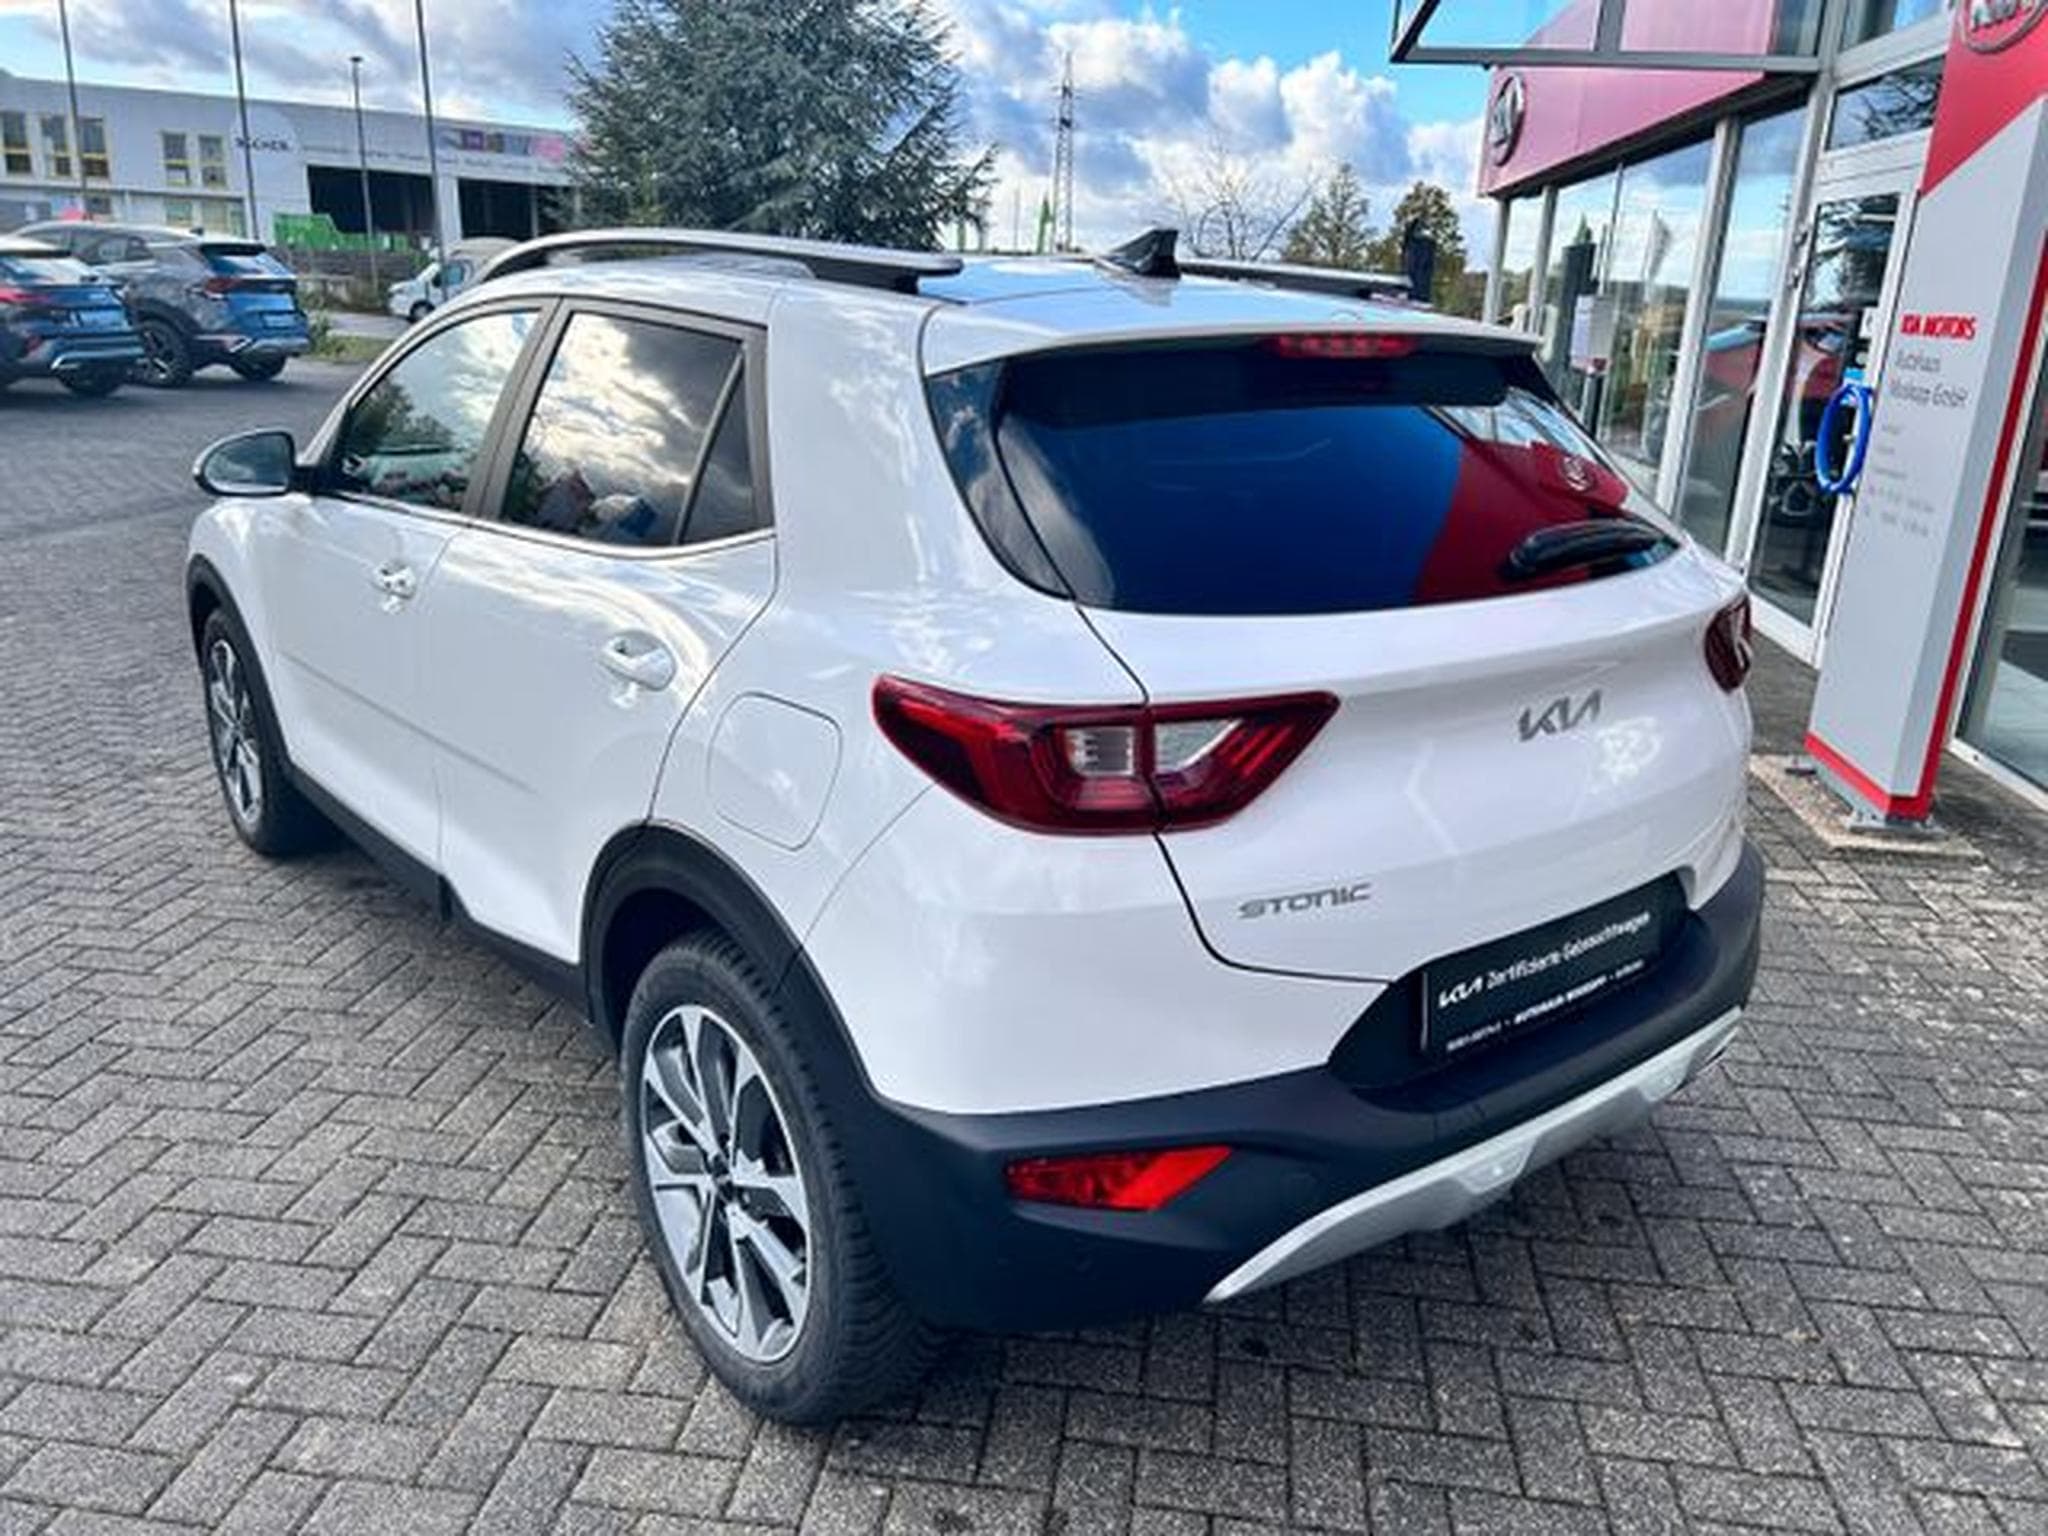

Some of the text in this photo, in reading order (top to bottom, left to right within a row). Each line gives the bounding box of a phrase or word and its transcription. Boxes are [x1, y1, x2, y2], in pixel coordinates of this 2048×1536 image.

[1518, 689, 1602, 741] KIA
[1238, 883, 1372, 919] STONIC
[1438, 975, 1485, 1009] KIA
